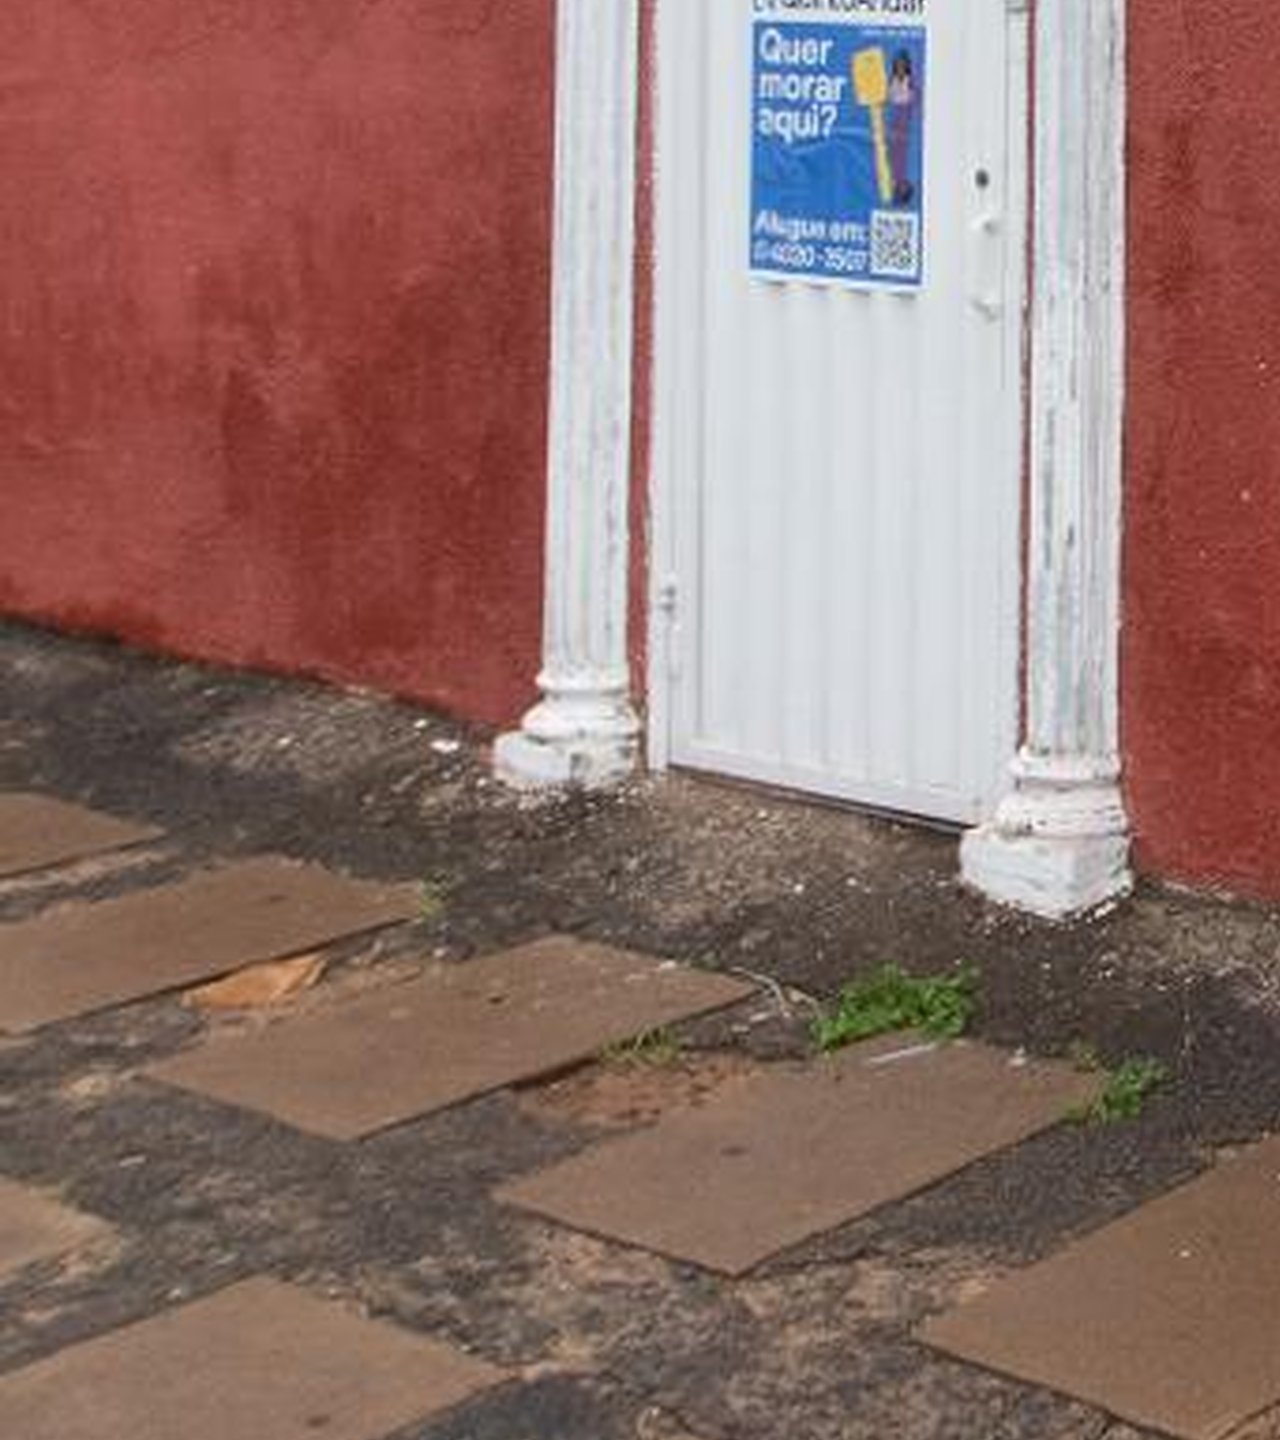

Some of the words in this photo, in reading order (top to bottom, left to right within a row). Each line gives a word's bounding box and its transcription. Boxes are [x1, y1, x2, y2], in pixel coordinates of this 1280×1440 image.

[758, 27, 834, 66] Quer
[758, 71, 845, 103] morar
[757, 104, 839, 143] aqui?
[754, 209, 826, 241] Alugue
